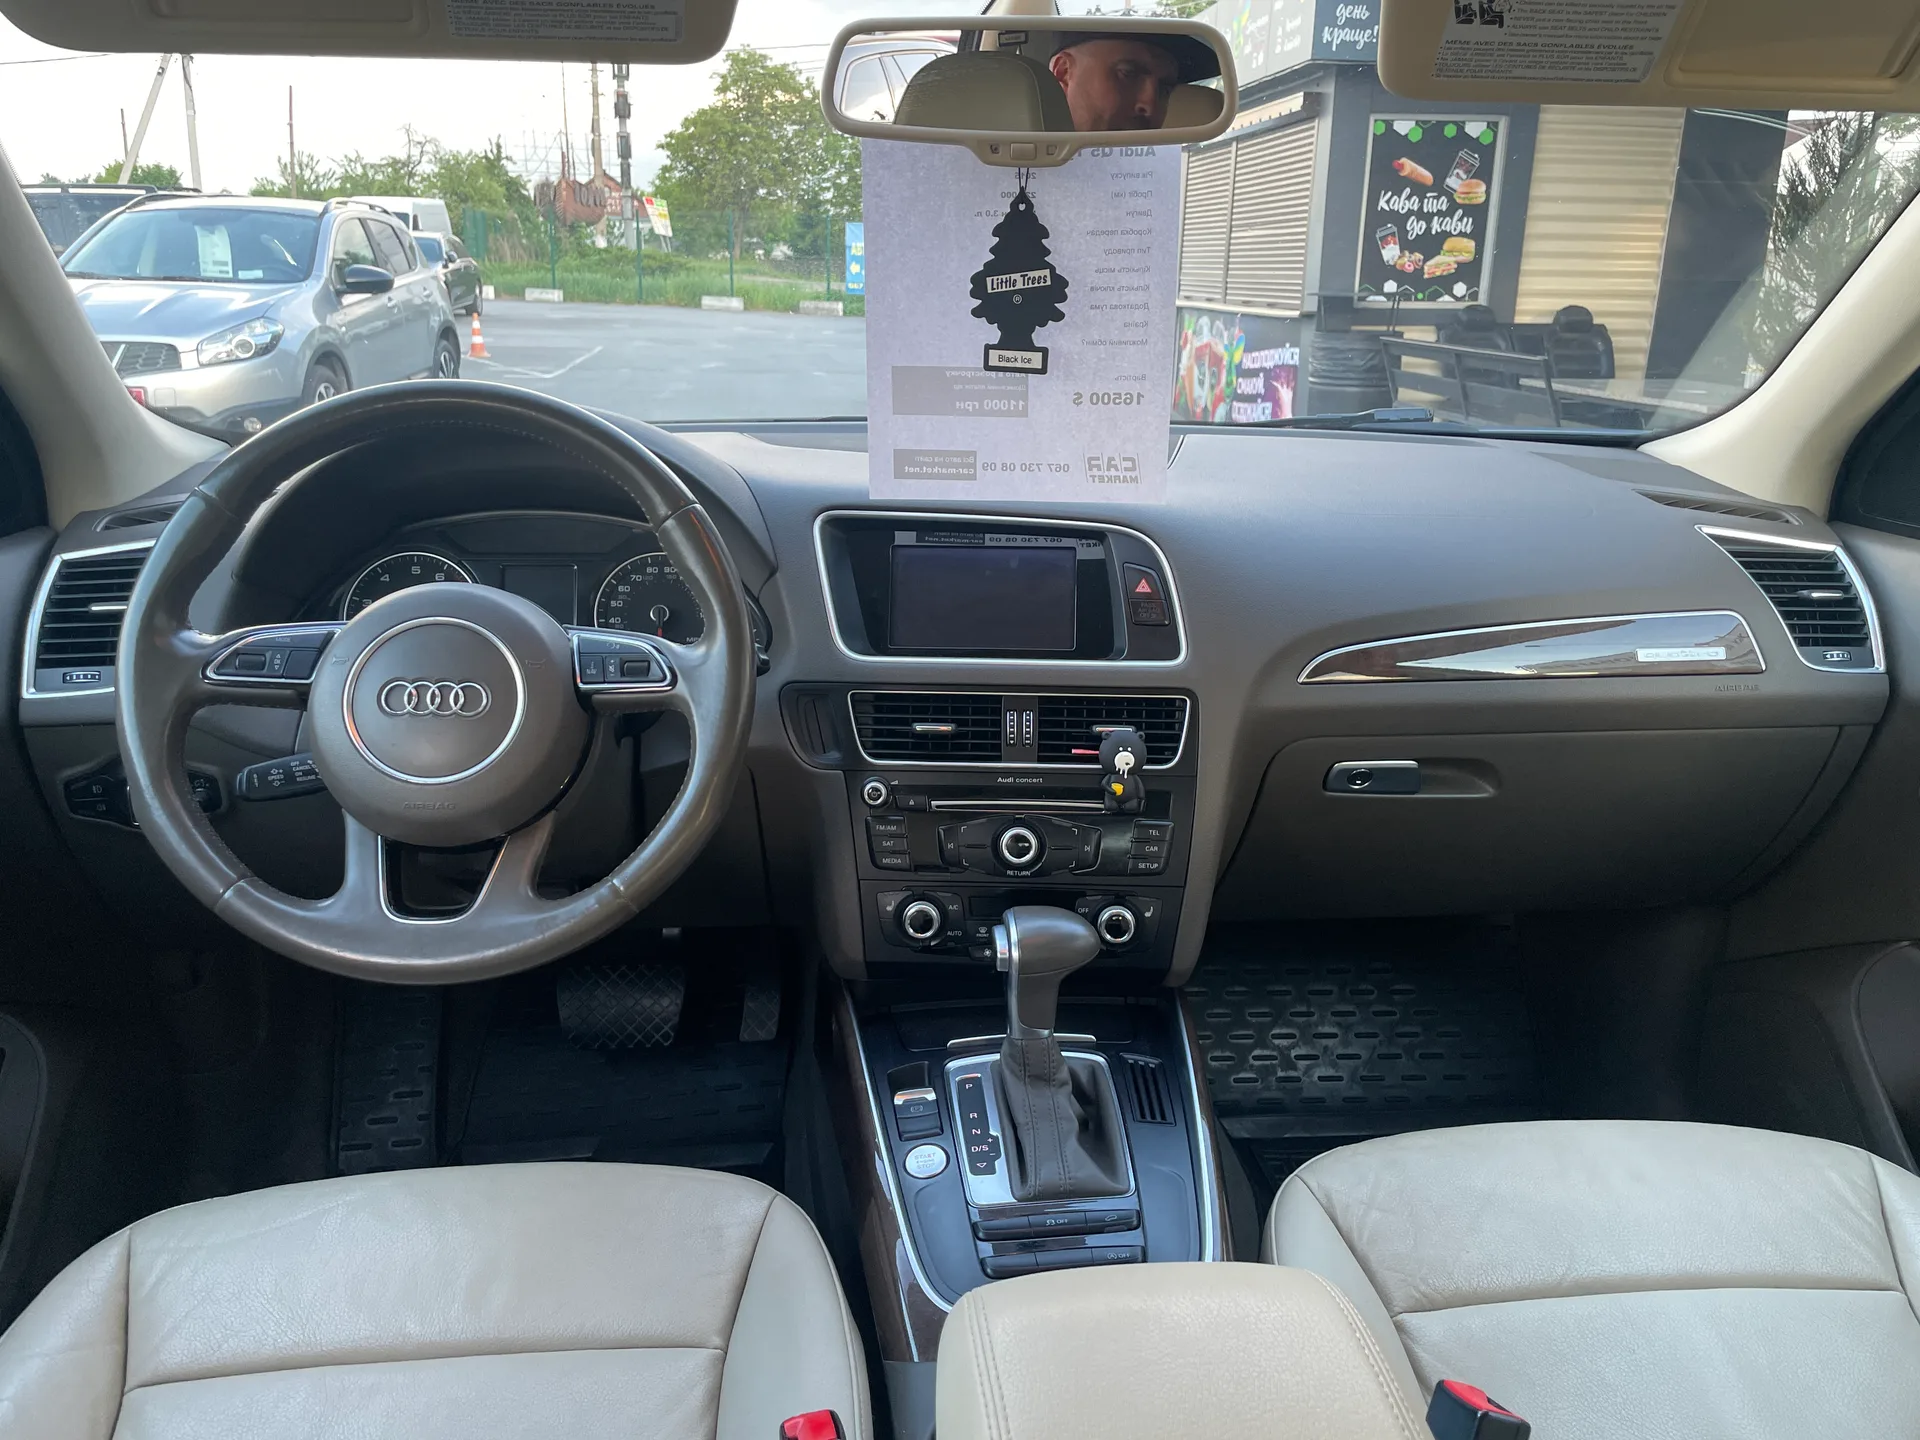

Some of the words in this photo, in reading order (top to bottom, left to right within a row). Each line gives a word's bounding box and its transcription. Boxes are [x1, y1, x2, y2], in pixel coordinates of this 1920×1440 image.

[1335, 4, 1370, 26] день
[1321, 25, 1379, 51] краще!
[1377, 187, 1421, 214] Кава
[1406, 215, 1428, 240] до
[1431, 208, 1475, 236] кави
[991, 276, 1017, 291] Little
[1020, 273, 1048, 287] Trees
[998, 354, 1019, 363] Black
[1020, 355, 1032, 365] Ice
[411, 566, 421, 575] 5
[380, 574, 390, 582] 4
[434, 573, 445, 581] 6
[402, 801, 456, 810] AIRBAG
[1006, 869, 1031, 877] RETURN
[971, 1144, 989, 1153] D/S
[914, 1152, 937, 1160] START
